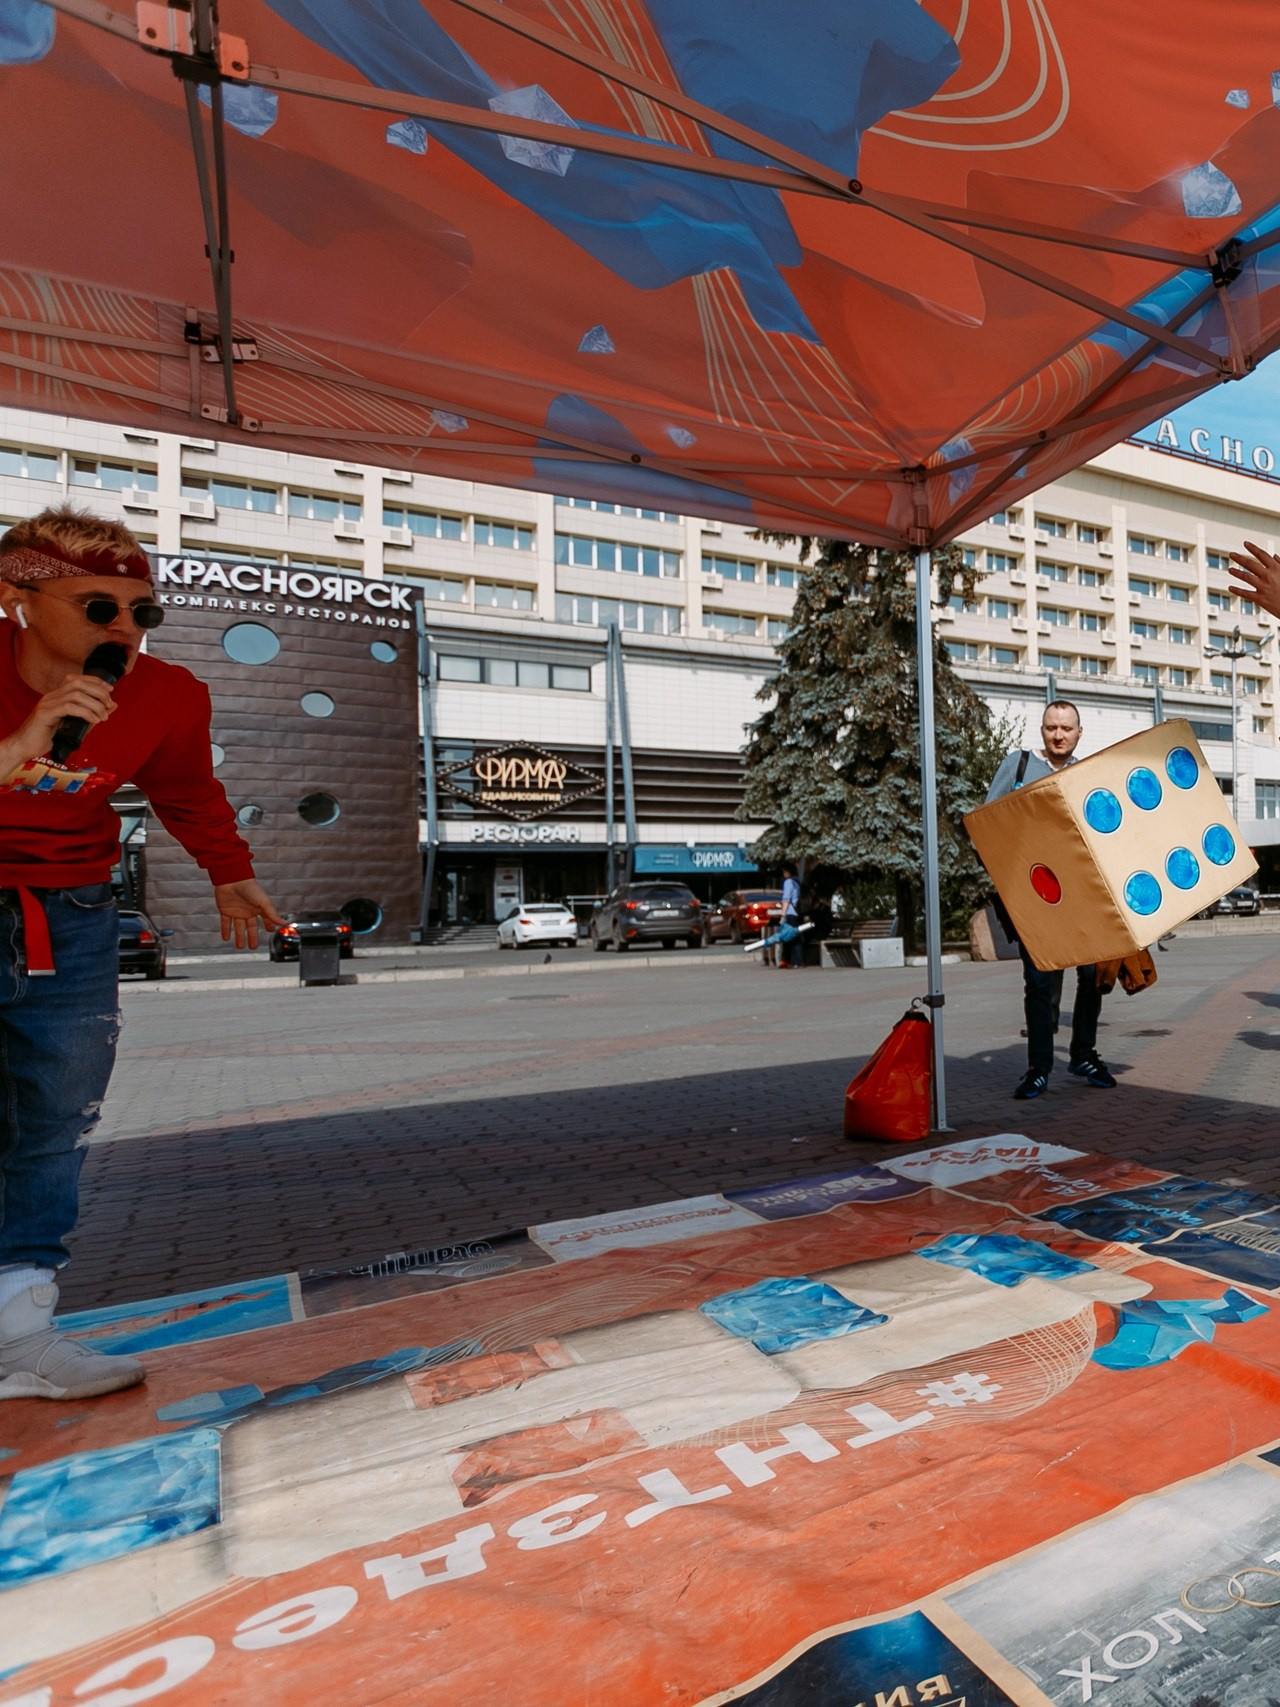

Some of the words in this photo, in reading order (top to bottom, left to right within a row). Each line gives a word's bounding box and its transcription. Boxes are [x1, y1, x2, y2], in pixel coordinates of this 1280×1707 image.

[157, 557, 413, 612] КРАСНОЯРСК
[160, 594, 277, 613] КОМПЛЕКС
[284, 605, 411, 630] РЕСТОРАНОВ
[475, 757, 567, 789] ФИРМА
[470, 825, 580, 842] РЕСТОРАН
[692, 851, 734, 868] ФИРМА
